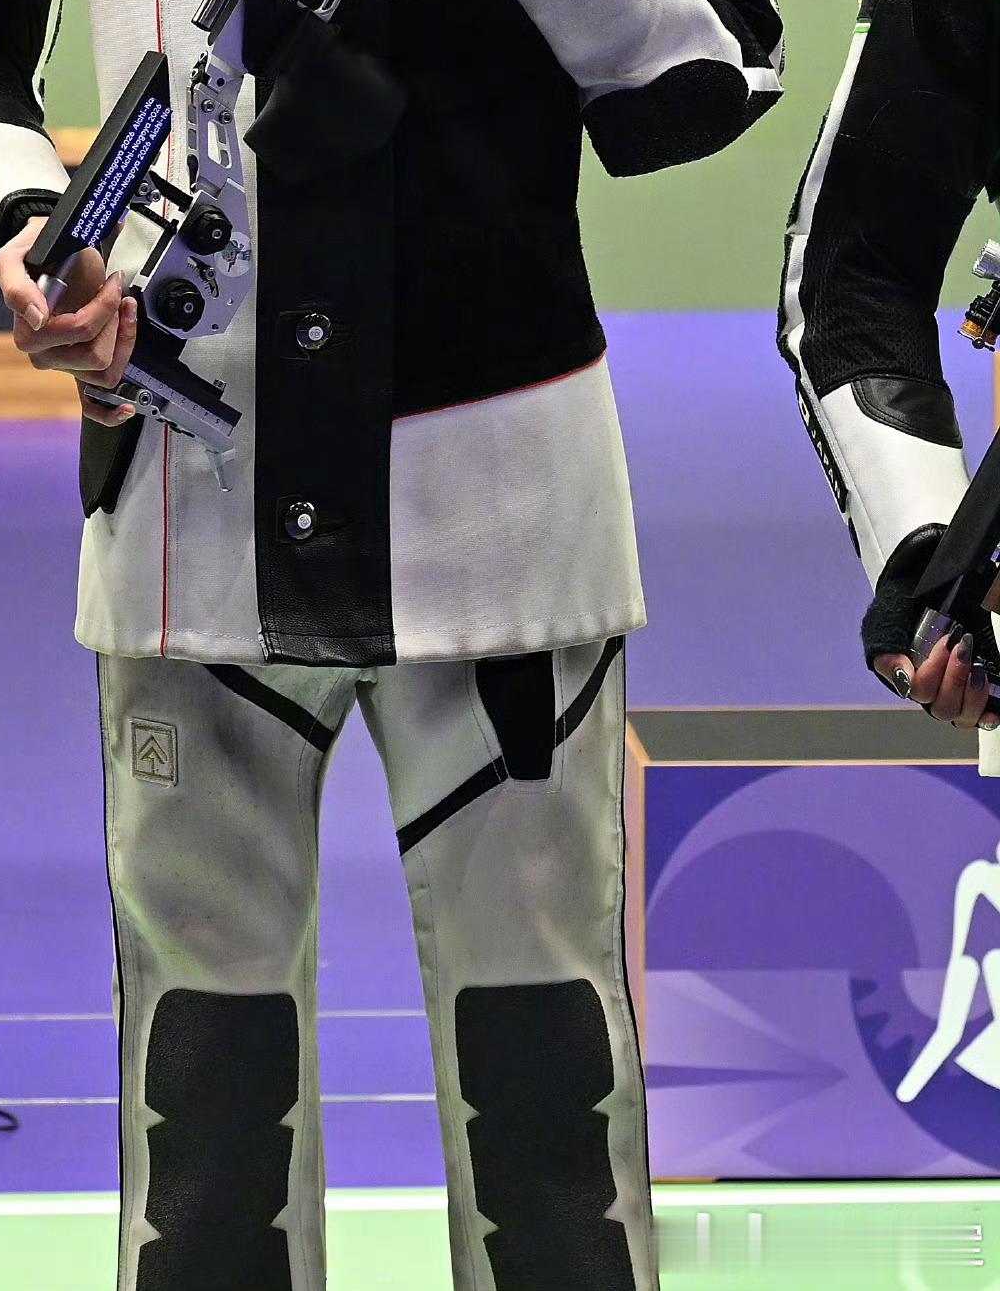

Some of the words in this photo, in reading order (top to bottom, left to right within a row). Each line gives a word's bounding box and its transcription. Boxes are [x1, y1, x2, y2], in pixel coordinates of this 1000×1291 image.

[71, 218, 84, 238] goya
[81, 200, 95, 218] 2026
[93, 150, 124, 199] Aichi-Nagoya
[120, 132, 135, 150] 2026
[132, 97, 154, 130] Aichi-Na
[80, 191, 112, 240] Aichi-Nagoya
[108, 172, 122, 191] 2026
[120, 122, 151, 171] Aichi-Nagoya
[148, 104, 162, 122] 2026
[97, 210, 112, 229] 2026
[110, 160, 140, 209] Aichi-Nagoya
[137, 141, 151, 160] 2026
[149, 107, 172, 140] Aichi-Na
[811, 430, 840, 498] JAPAN
